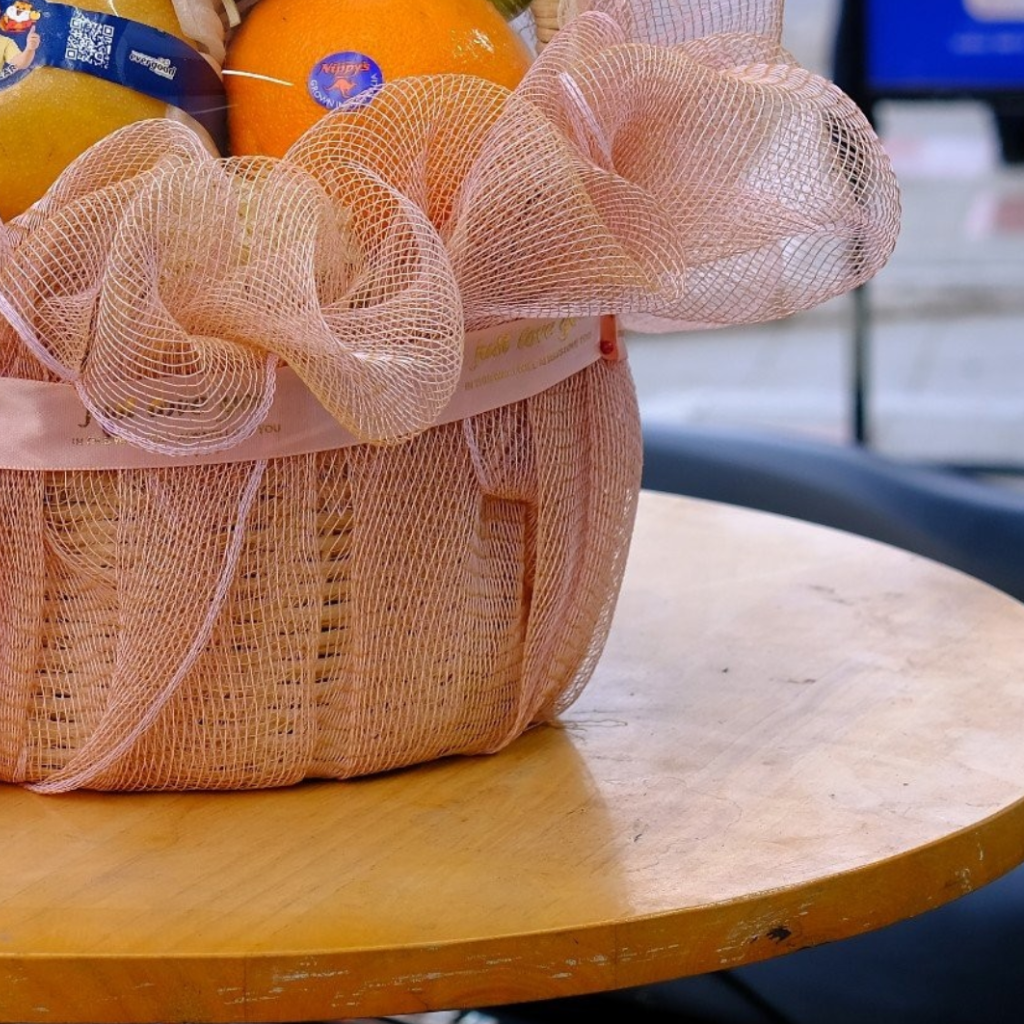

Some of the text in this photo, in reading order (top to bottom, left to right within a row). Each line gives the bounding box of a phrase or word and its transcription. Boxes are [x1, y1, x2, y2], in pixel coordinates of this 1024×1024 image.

[129, 51, 177, 79] evergood
[310, 79, 335, 107] GROWN
[259, 423, 282, 434] YOU
